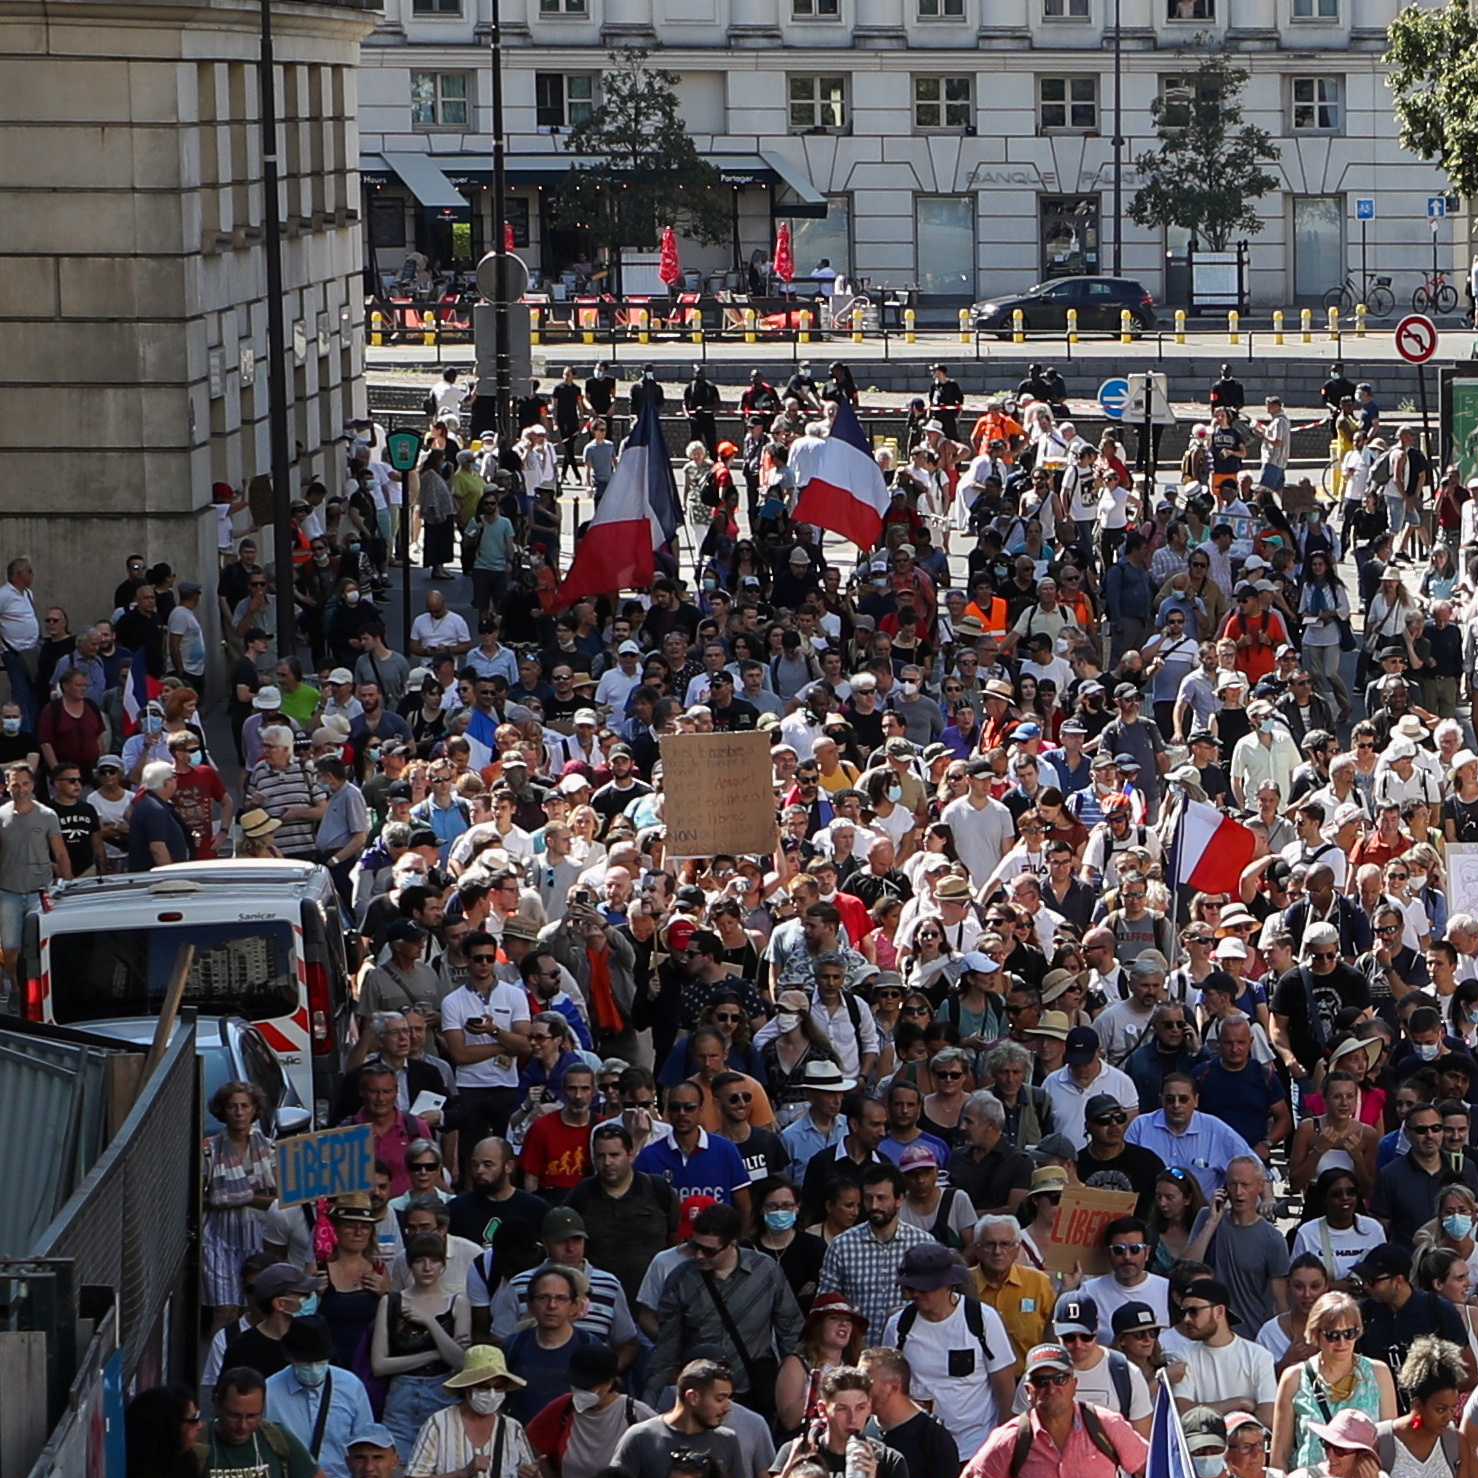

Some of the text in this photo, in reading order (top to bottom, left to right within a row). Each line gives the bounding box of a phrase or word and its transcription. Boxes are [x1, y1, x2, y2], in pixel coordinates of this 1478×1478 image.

[967, 170, 1056, 184] BANQUE
[61, 816, 92, 825] EFEND
[239, 912, 277, 921] Sanicar
[1068, 1303, 1080, 1319] D
